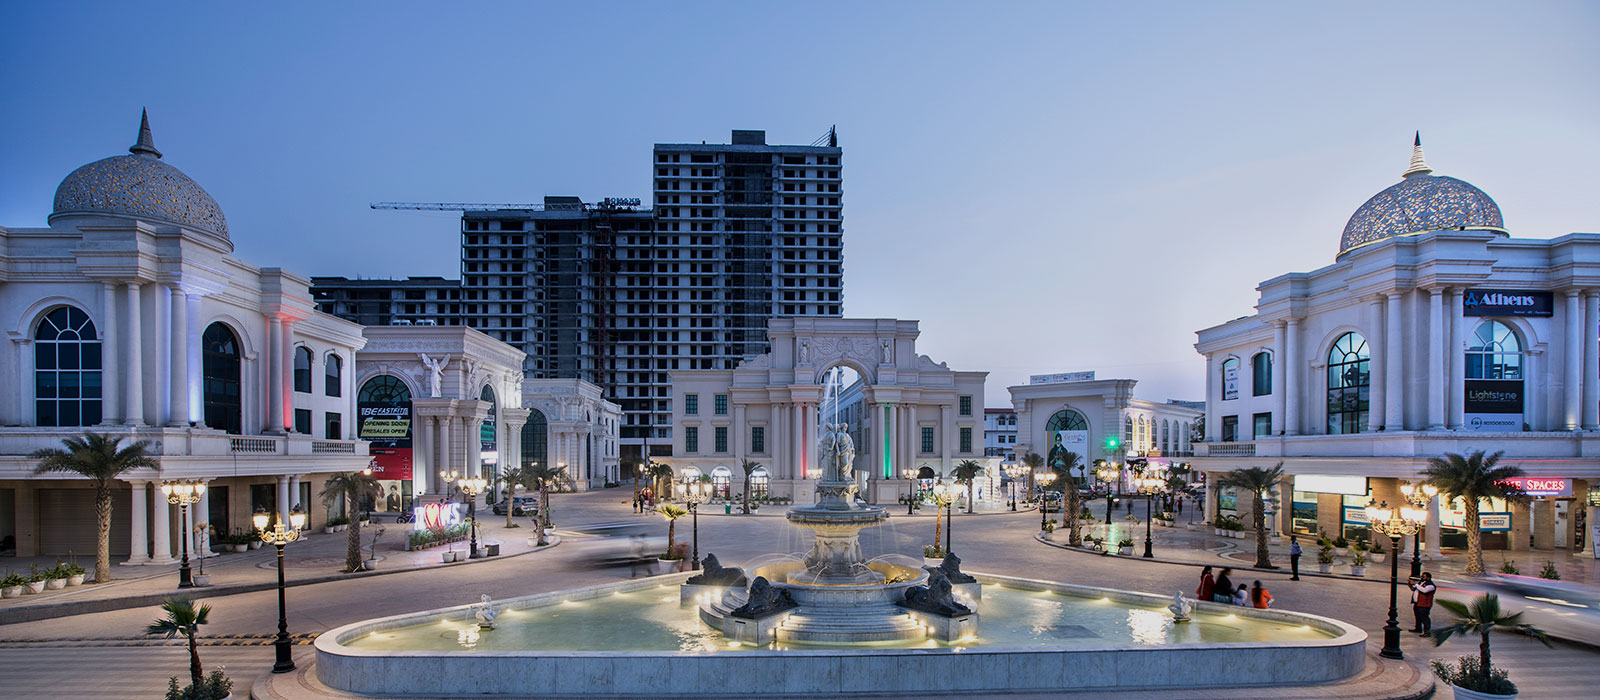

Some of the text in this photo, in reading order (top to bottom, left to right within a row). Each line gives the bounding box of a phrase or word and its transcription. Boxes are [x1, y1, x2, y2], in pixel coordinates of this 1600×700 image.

[1479, 292, 1535, 306] Athens
[1469, 390, 1518, 401] Lightstone
[1526, 479, 1566, 491] SPACES
